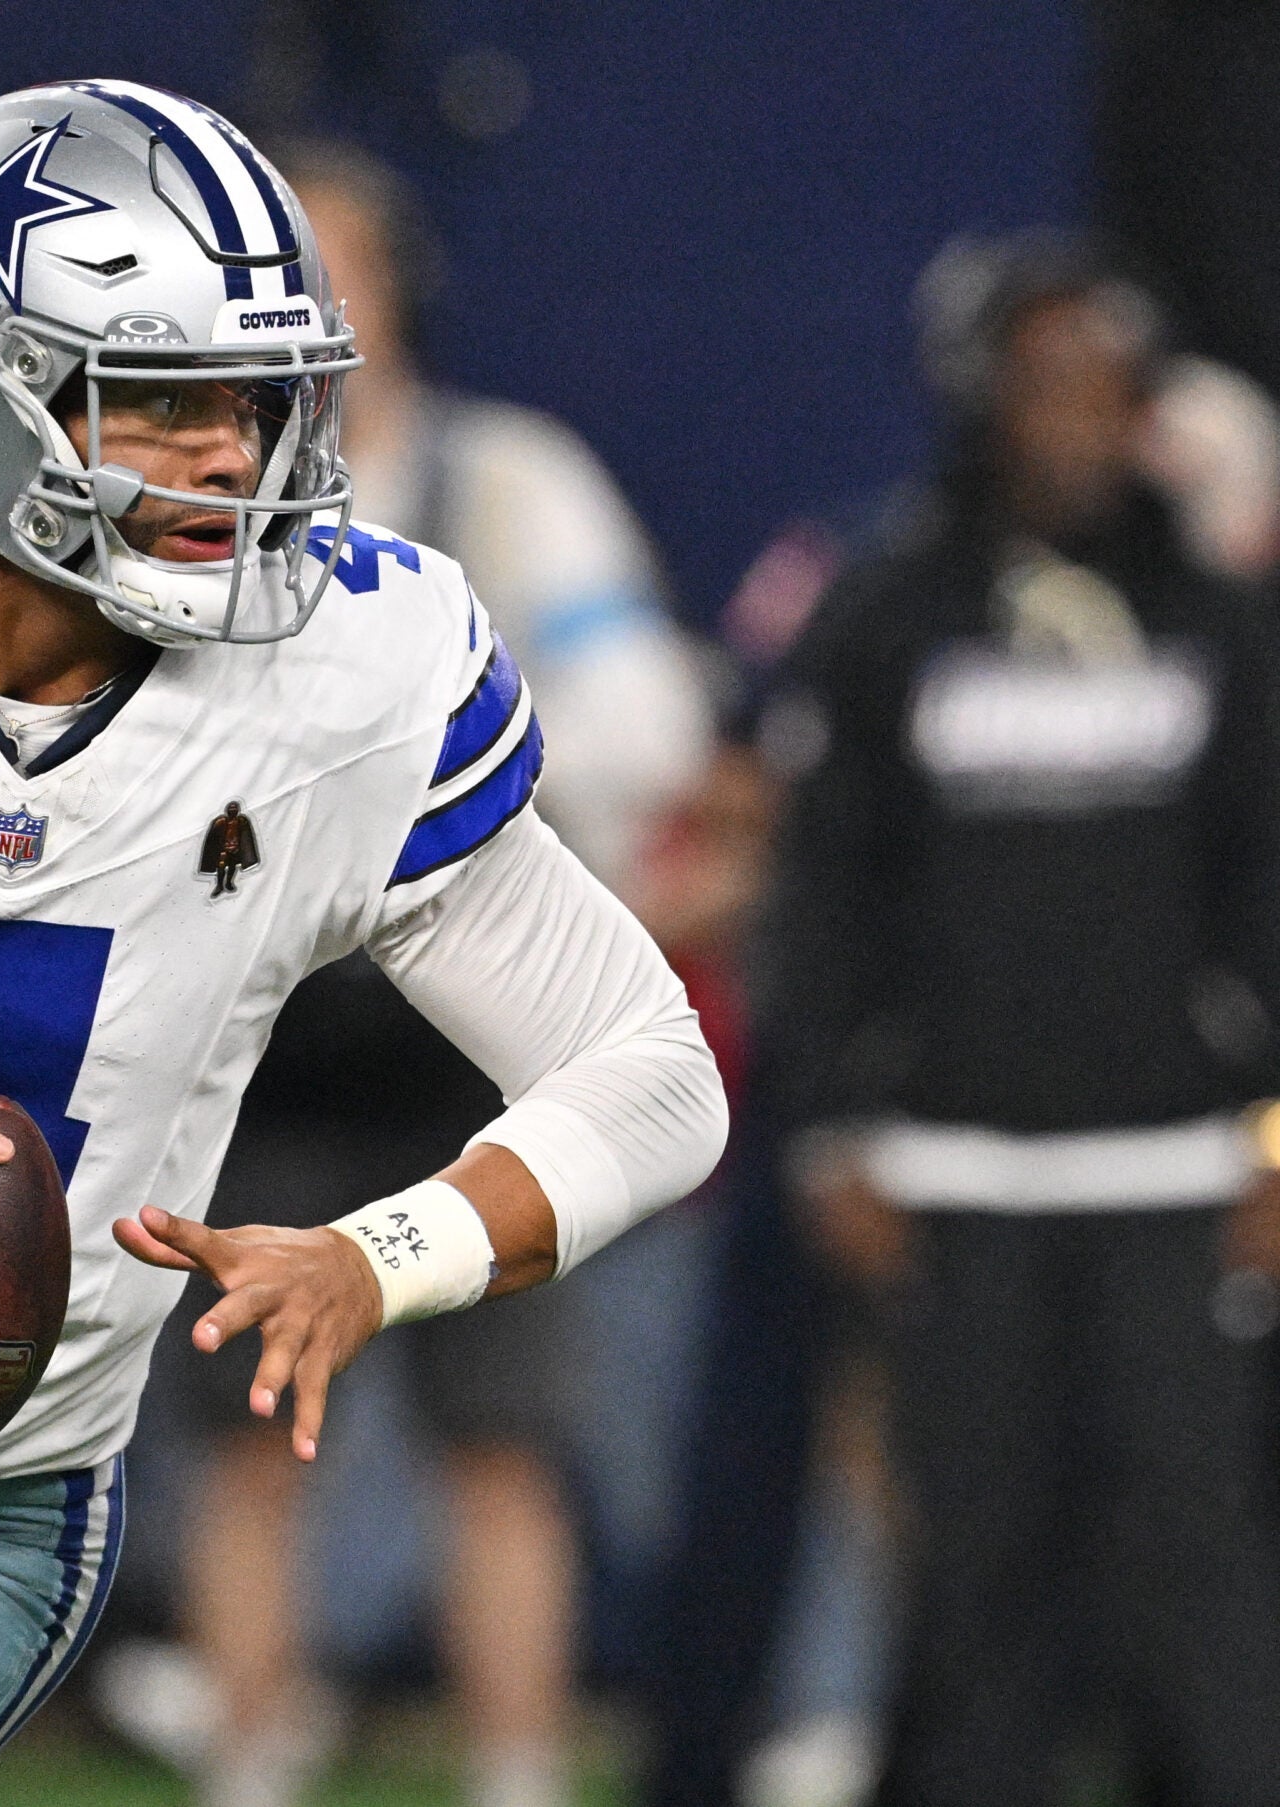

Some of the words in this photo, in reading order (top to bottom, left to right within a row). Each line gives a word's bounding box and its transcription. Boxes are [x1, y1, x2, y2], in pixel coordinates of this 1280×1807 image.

[239, 308, 310, 330] COWBOYS
[290, 524, 421, 595] 4
[385, 1234, 401, 1249] 4
[387, 1212, 430, 1261] ASK
